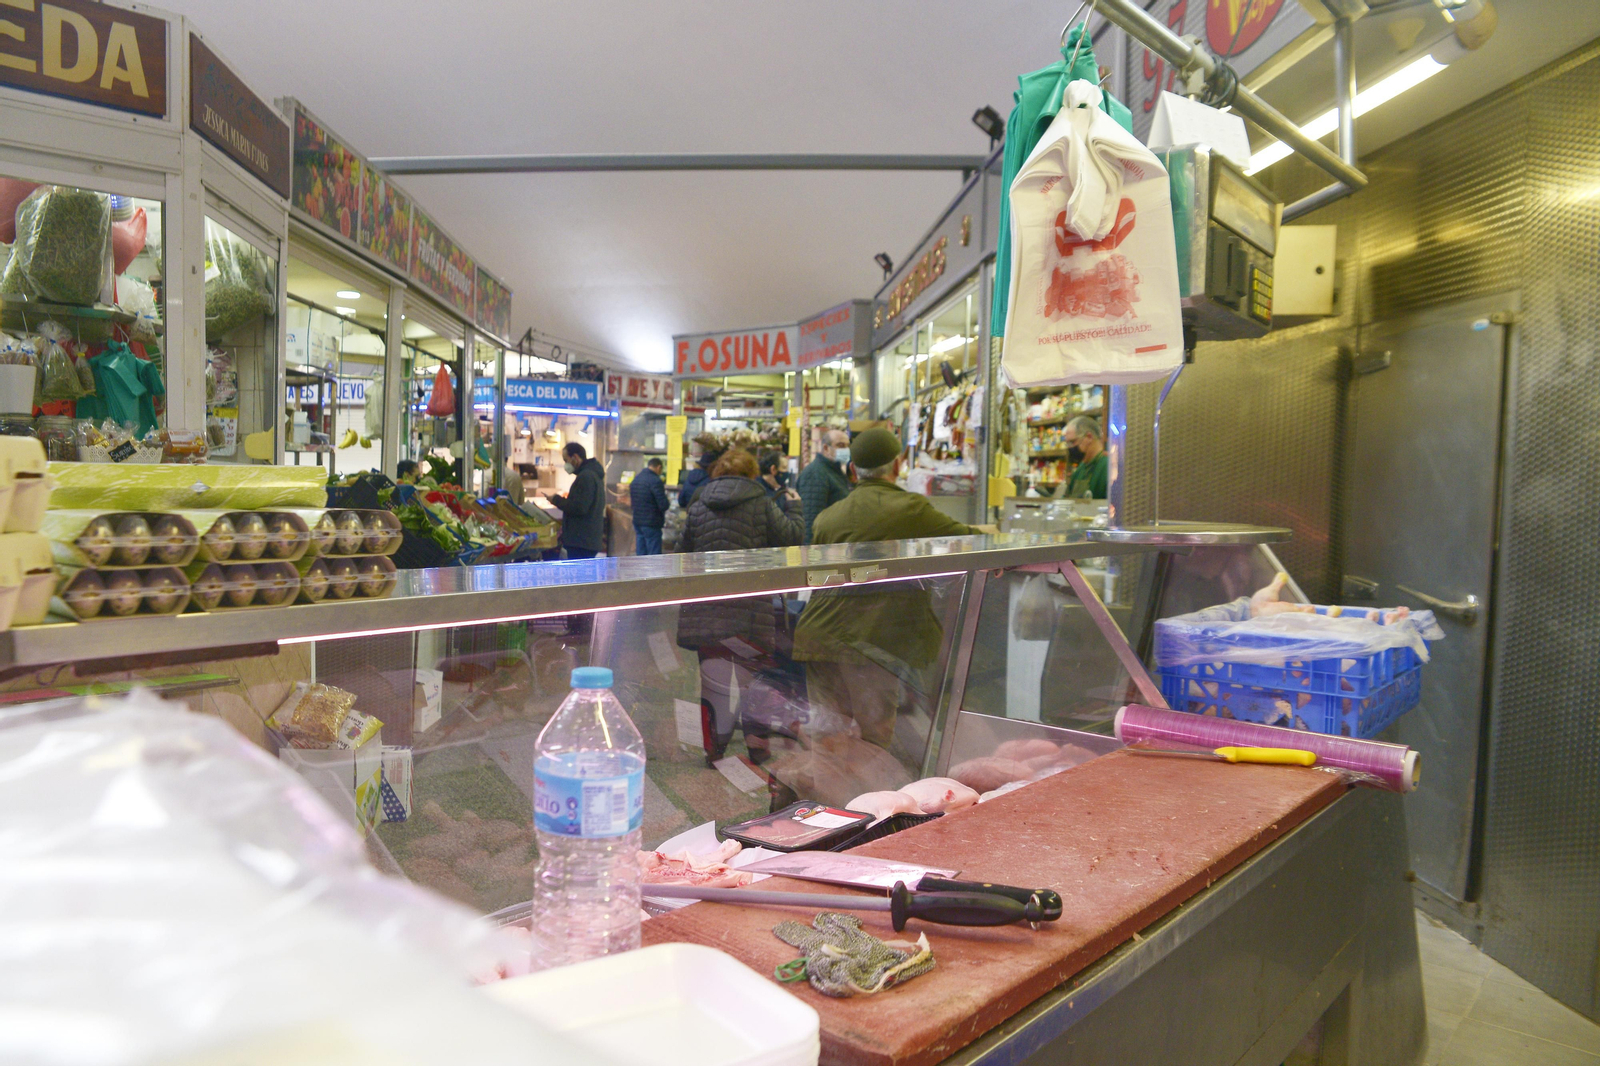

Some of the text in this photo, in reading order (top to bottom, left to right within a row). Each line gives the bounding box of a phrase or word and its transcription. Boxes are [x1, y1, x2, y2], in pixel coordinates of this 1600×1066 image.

[202, 103, 230, 142] JESSICA
[801, 307, 850, 337] ESPECIES
[677, 331, 792, 374] F.OSUNA
[536, 385, 557, 399] DEL
[559, 386, 579, 400] DIA
[585, 392, 594, 400] 91
